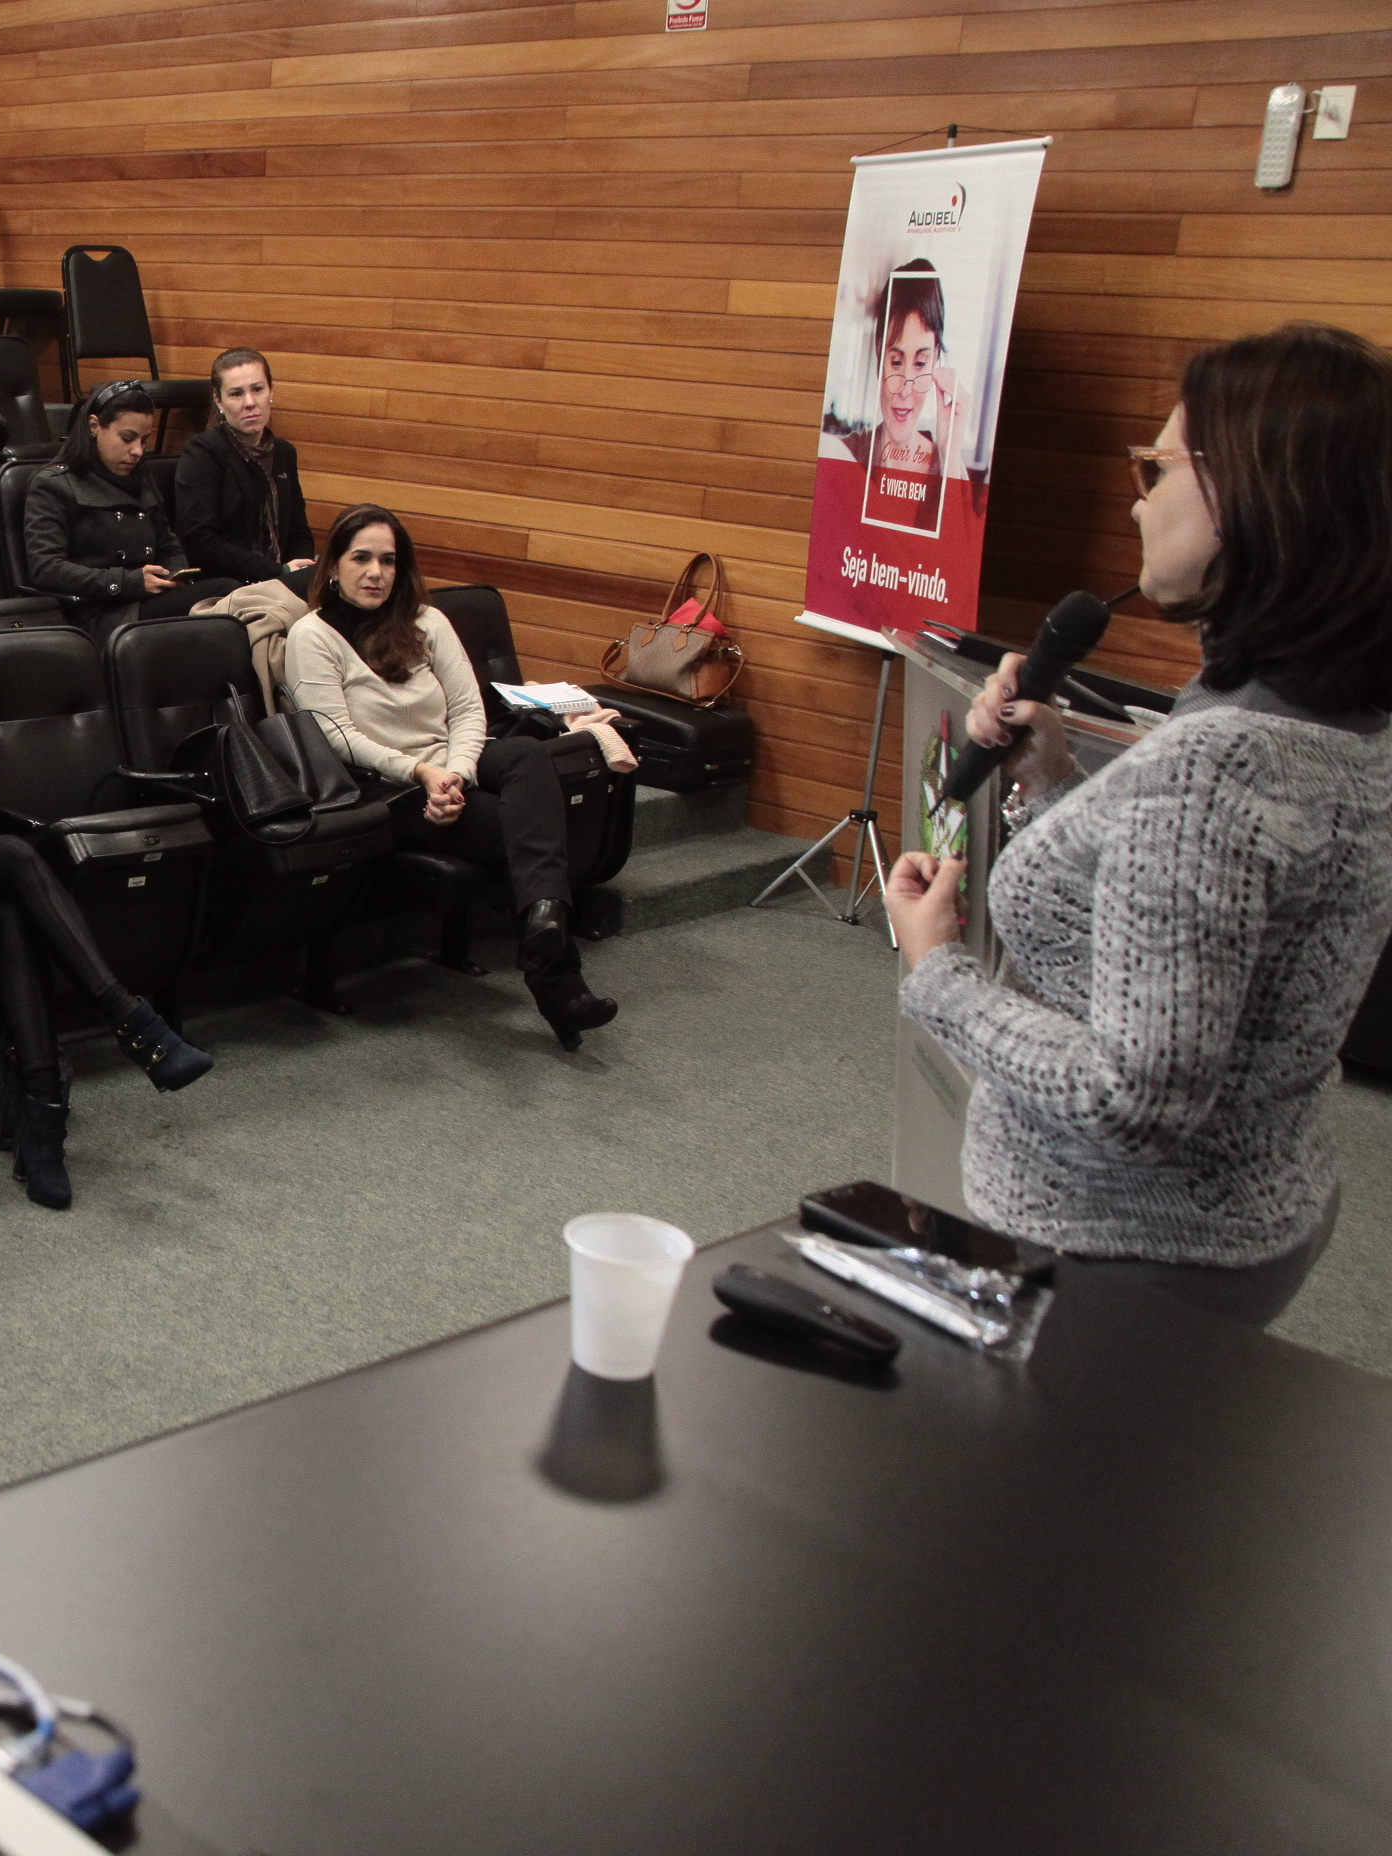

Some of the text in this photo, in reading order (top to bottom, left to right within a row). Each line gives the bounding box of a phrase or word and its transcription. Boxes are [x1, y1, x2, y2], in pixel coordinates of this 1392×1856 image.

[908, 210, 956, 226] AUDIBEL
[881, 441, 910, 462] Ouvir
[879, 473, 927, 502] É VIVER BEM
[841, 546, 949, 604] Seja bem-vindo.
